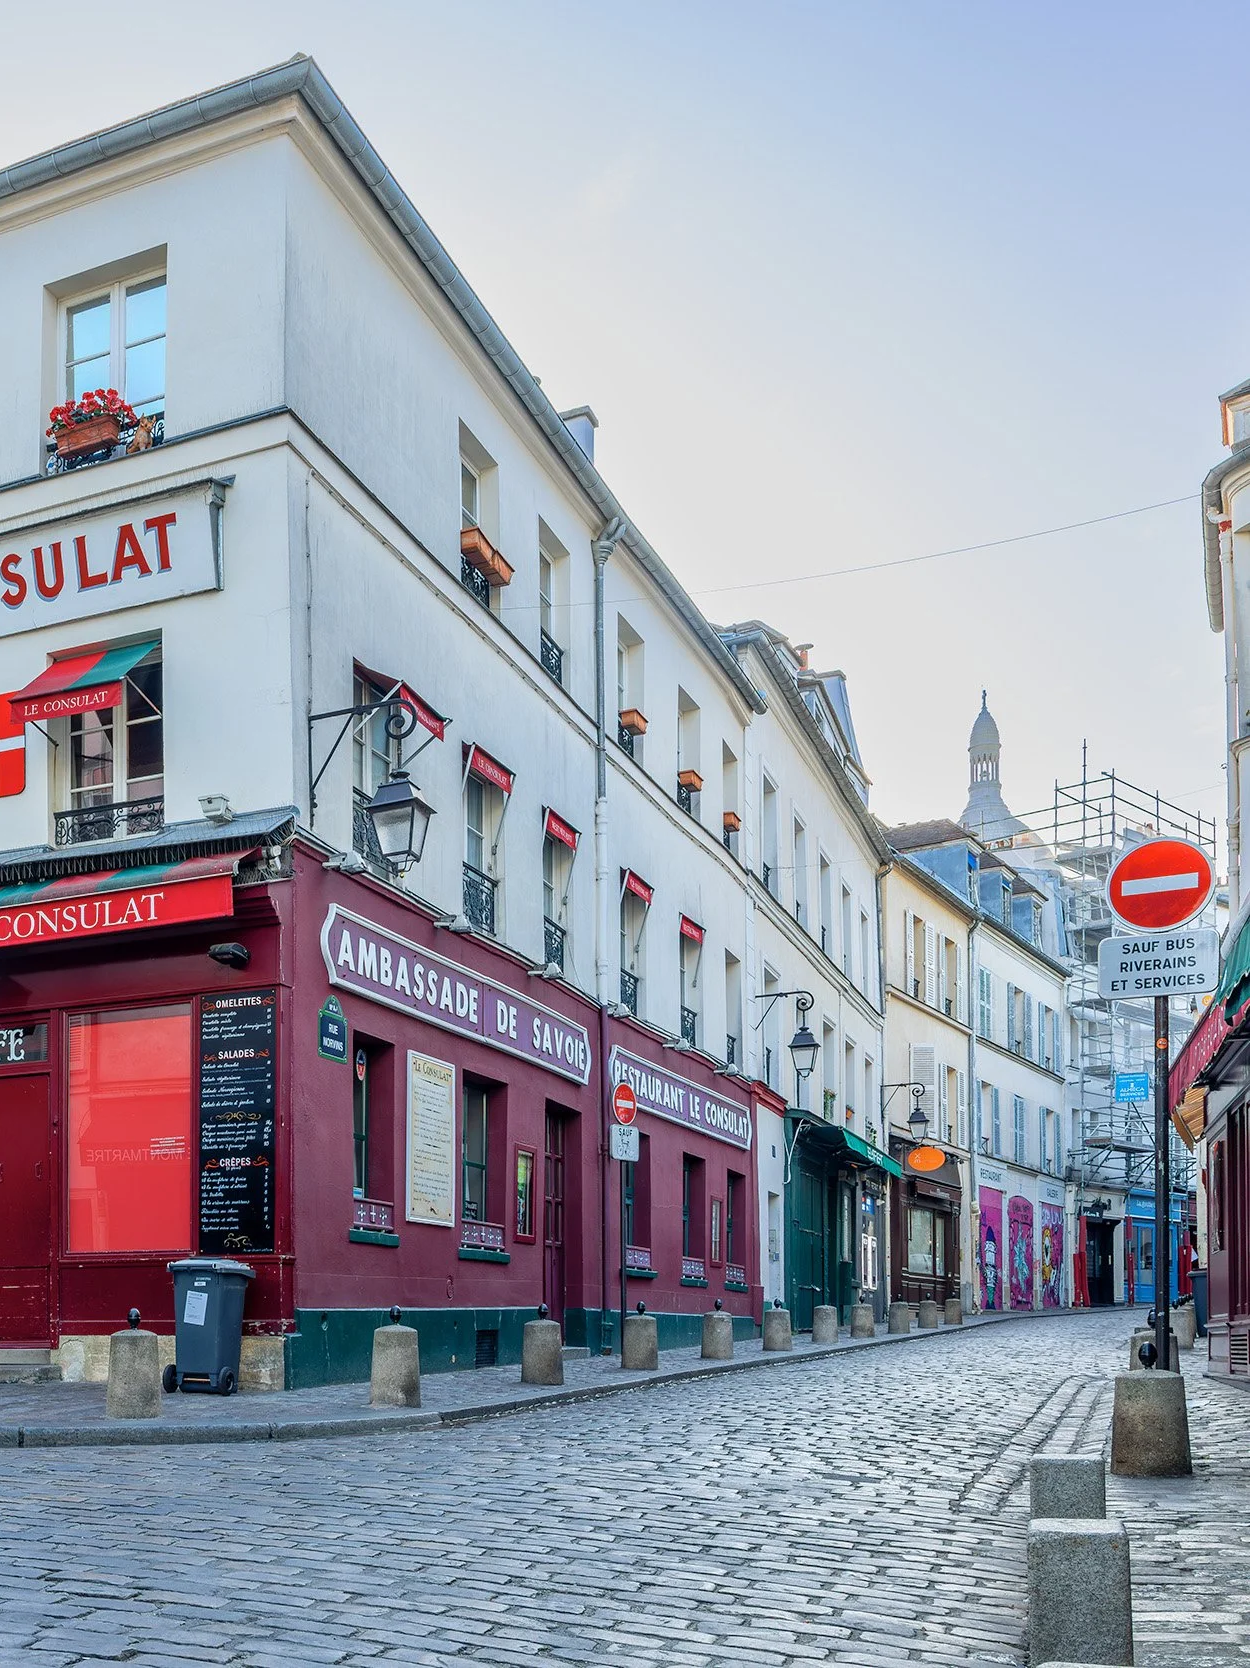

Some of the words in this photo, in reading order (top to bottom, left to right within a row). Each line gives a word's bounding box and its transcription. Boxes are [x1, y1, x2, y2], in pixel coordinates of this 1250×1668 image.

[24, 703, 39, 717] LE
[43, 690, 108, 713] CONSULAT
[1121, 939, 1159, 955] SAUF
[1165, 936, 1196, 952] BUS
[1119, 955, 1197, 973] RIVERAINS
[1110, 977, 1129, 992] ET
[1135, 972, 1206, 990] SERVICES
[215, 996, 262, 1008] OMELETTES
[337, 929, 479, 1025] AMBASSADE
[496, 999, 517, 1040] DE
[534, 1020, 587, 1072] SAVOIE
[328, 1023, 339, 1035] RUE
[322, 1035, 344, 1052] NORVINS
[218, 1048, 255, 1060] SALADES
[614, 1059, 686, 1113] RESTAURANT
[690, 1093, 701, 1121] LE
[705, 1100, 748, 1140] CONSULAT
[618, 1127, 633, 1137] SAUF
[219, 1156, 251, 1167] CRÊPES
